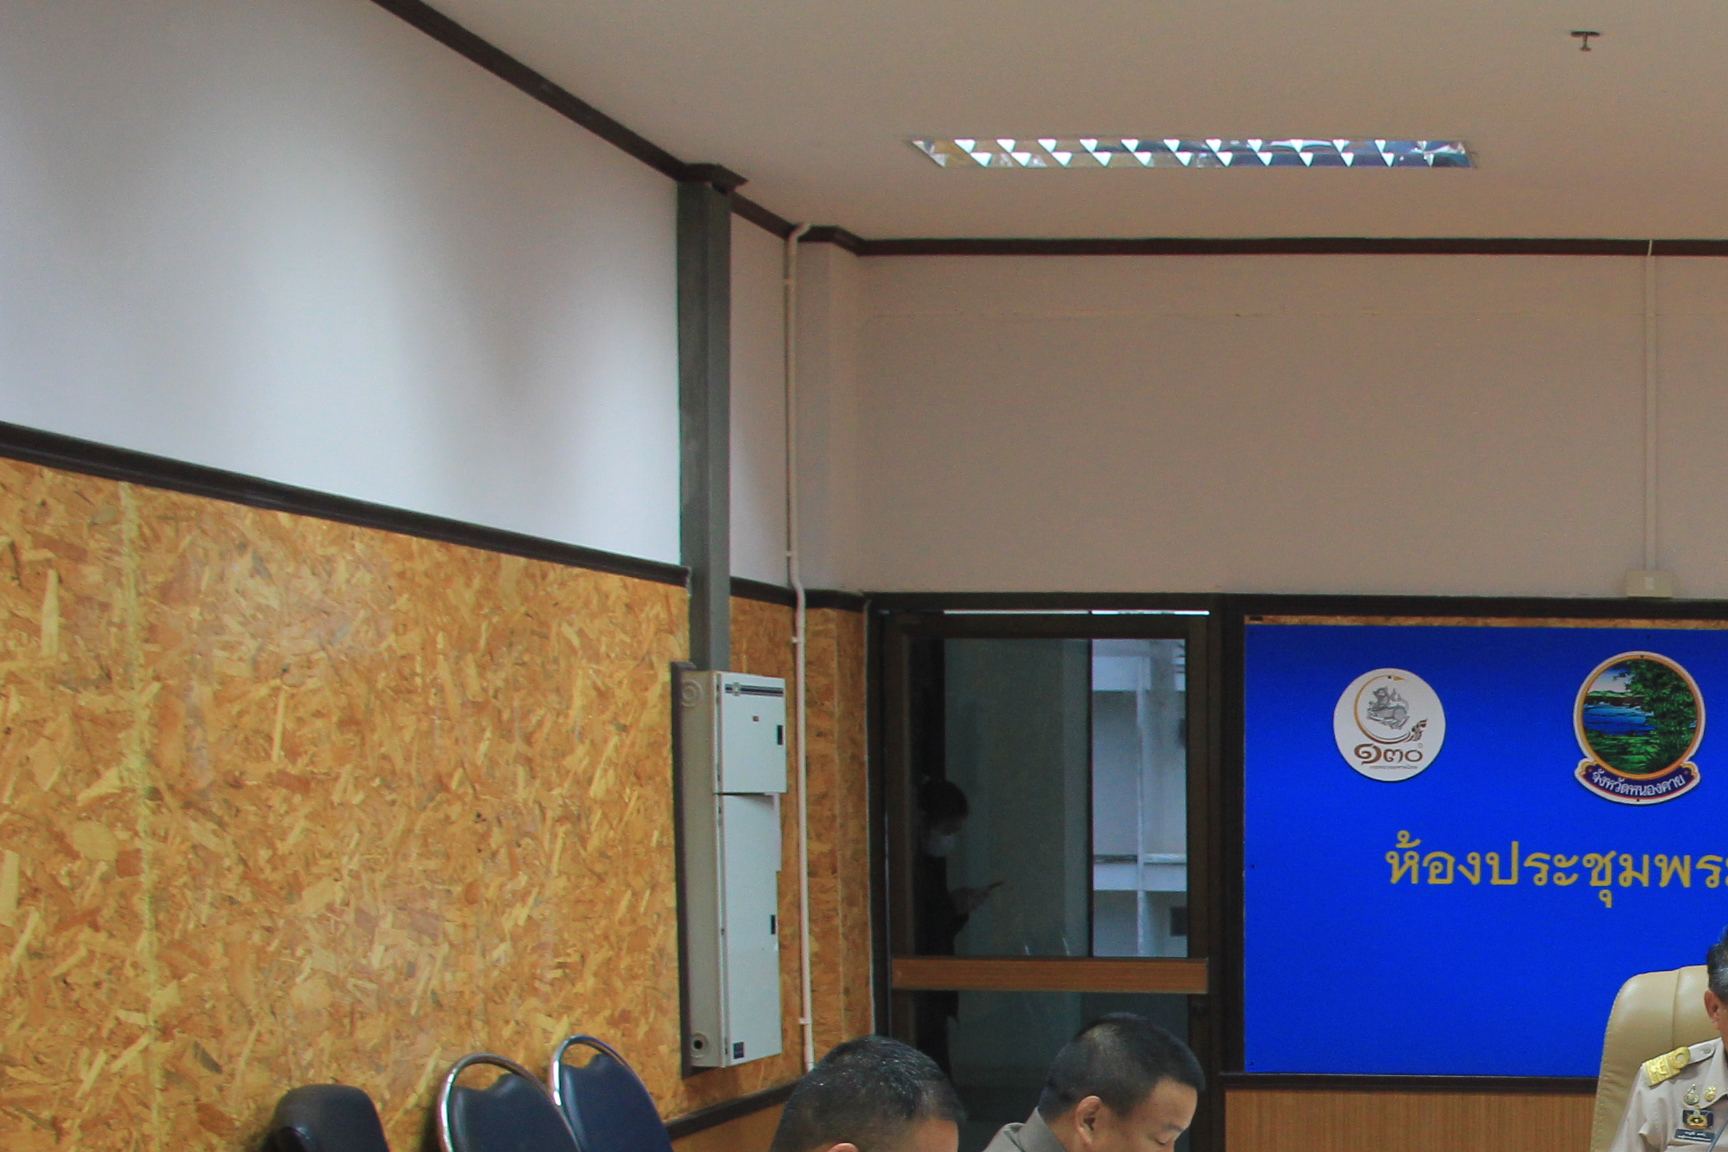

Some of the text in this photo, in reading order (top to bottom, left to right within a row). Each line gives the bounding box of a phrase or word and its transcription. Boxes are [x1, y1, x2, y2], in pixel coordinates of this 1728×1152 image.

[1592, 768, 1686, 796] จังหวัดหนองคาย
